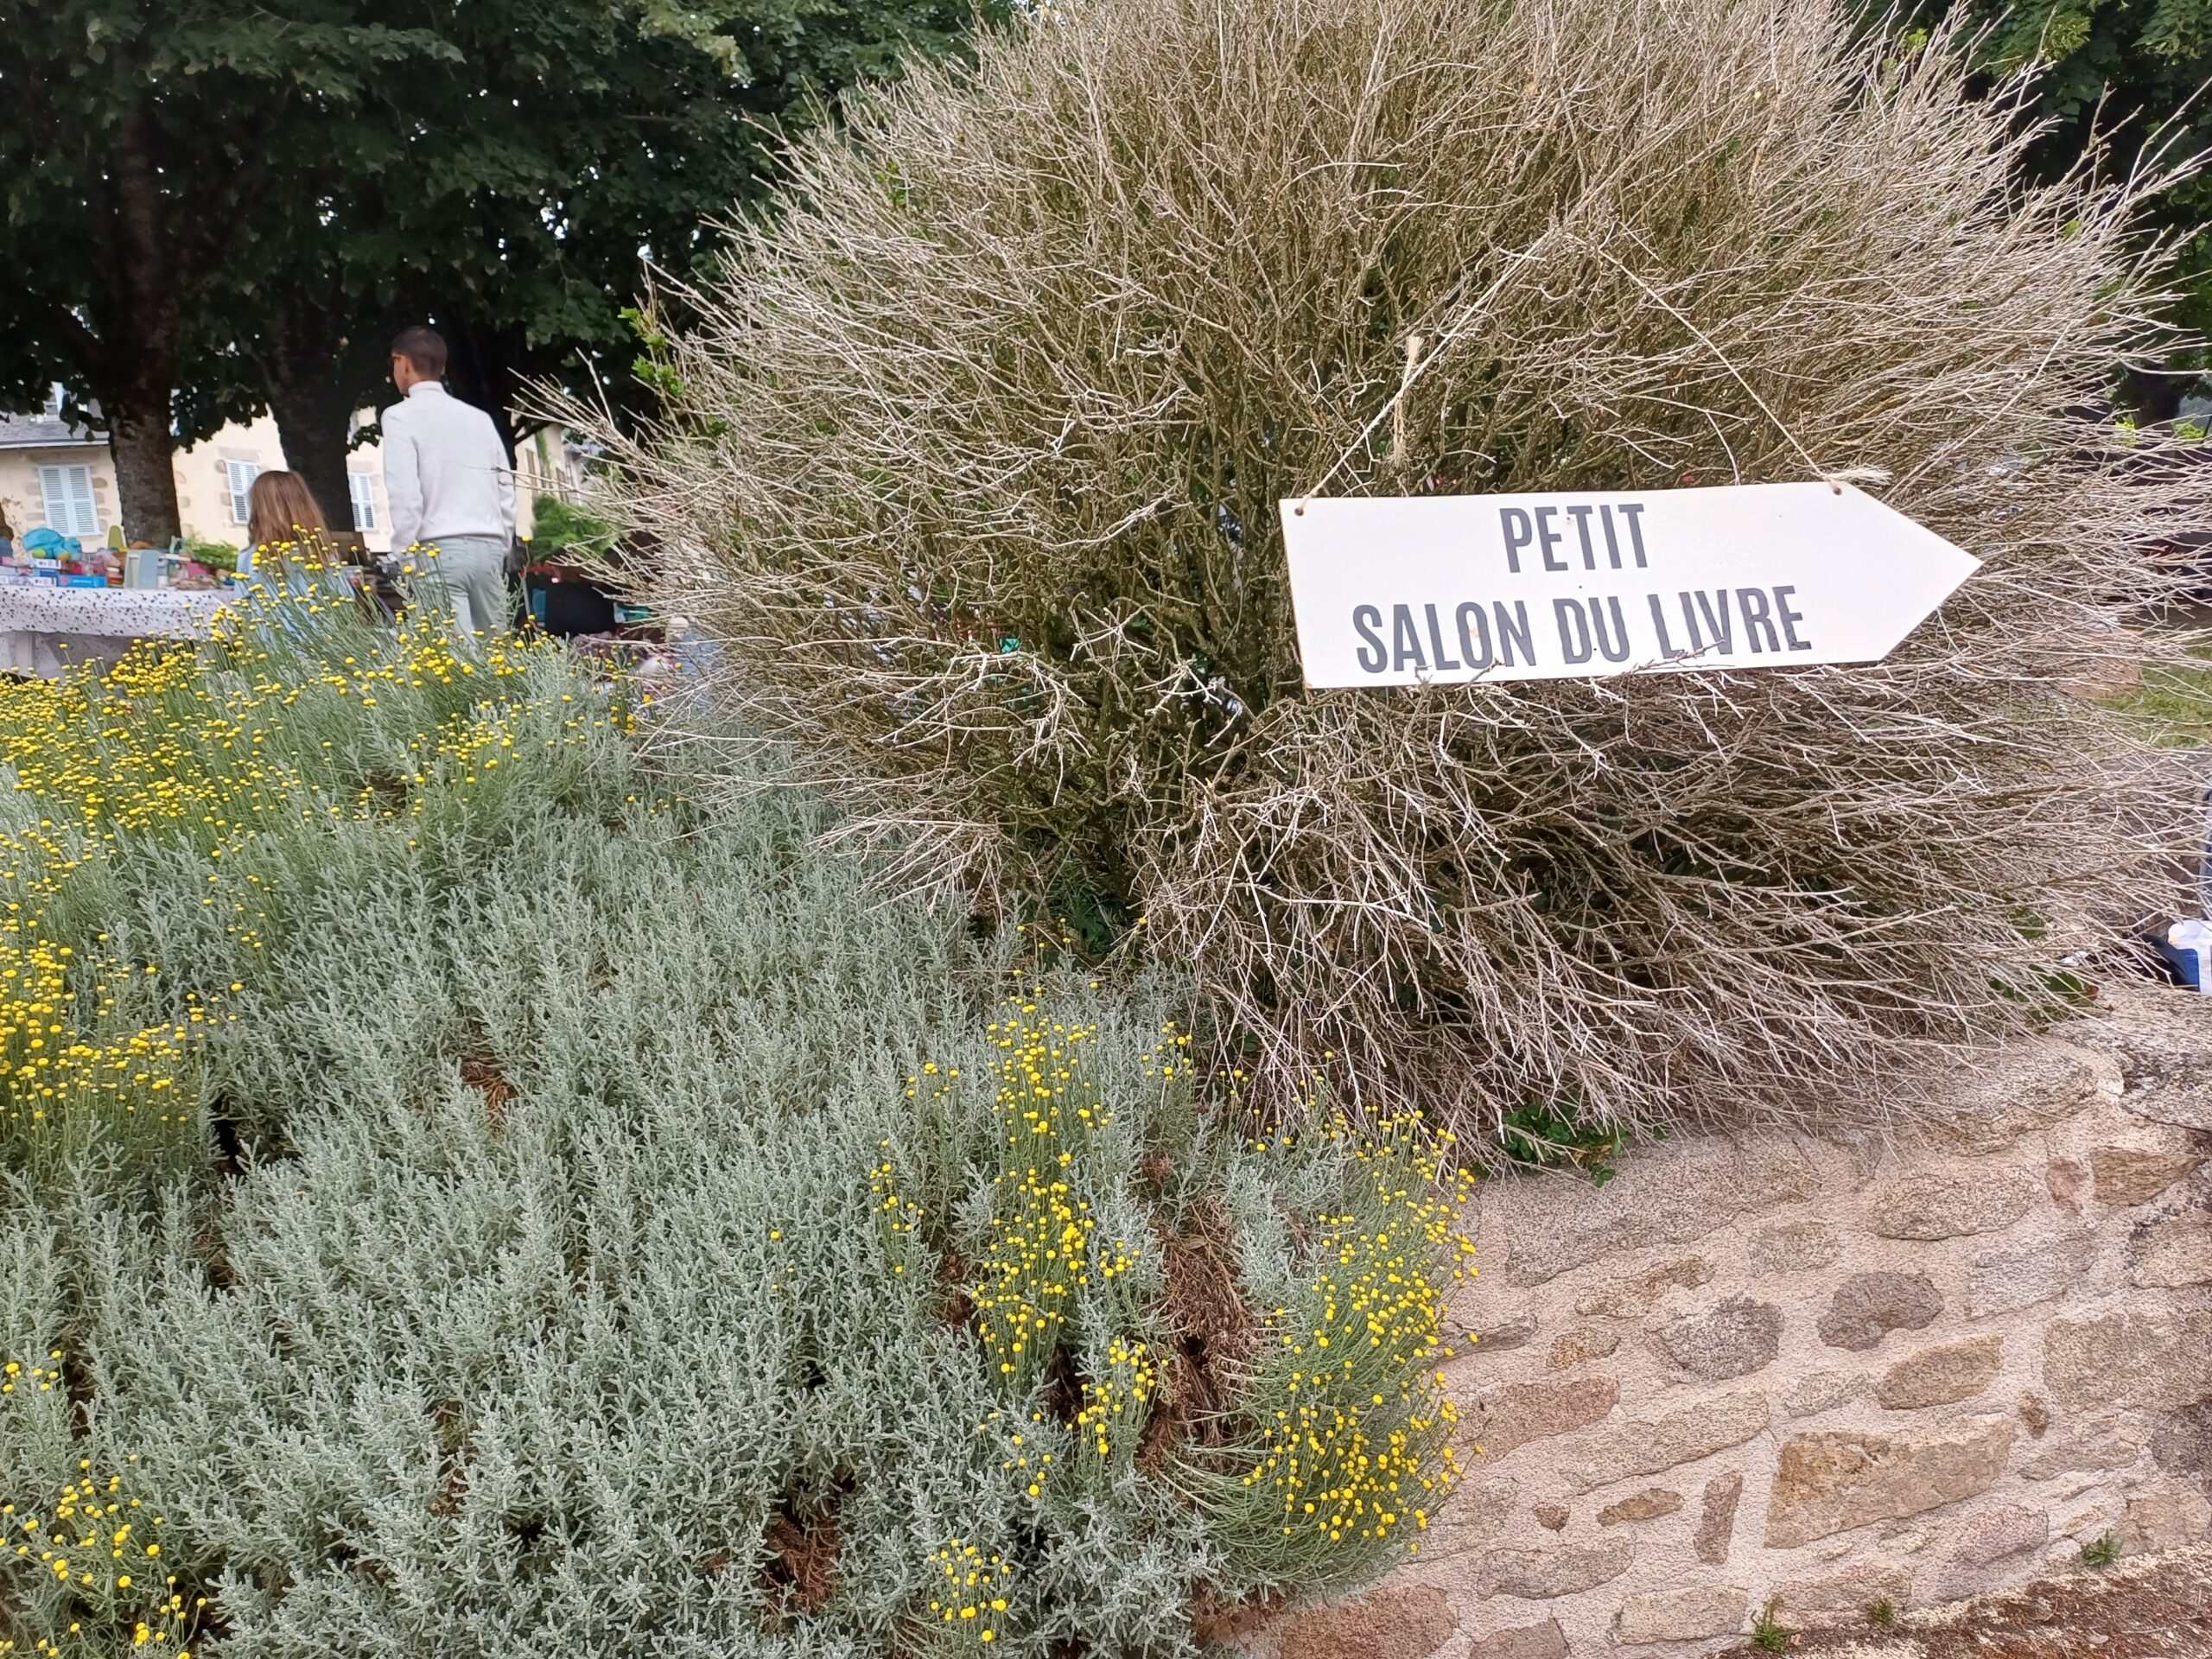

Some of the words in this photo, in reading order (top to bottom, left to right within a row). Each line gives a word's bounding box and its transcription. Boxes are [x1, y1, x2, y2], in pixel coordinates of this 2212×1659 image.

[1499, 503, 1648, 573] PETIT
[1352, 600, 1536, 674] SALON
[1552, 595, 1630, 664] DU
[1647, 585, 1812, 659] LIVRE
